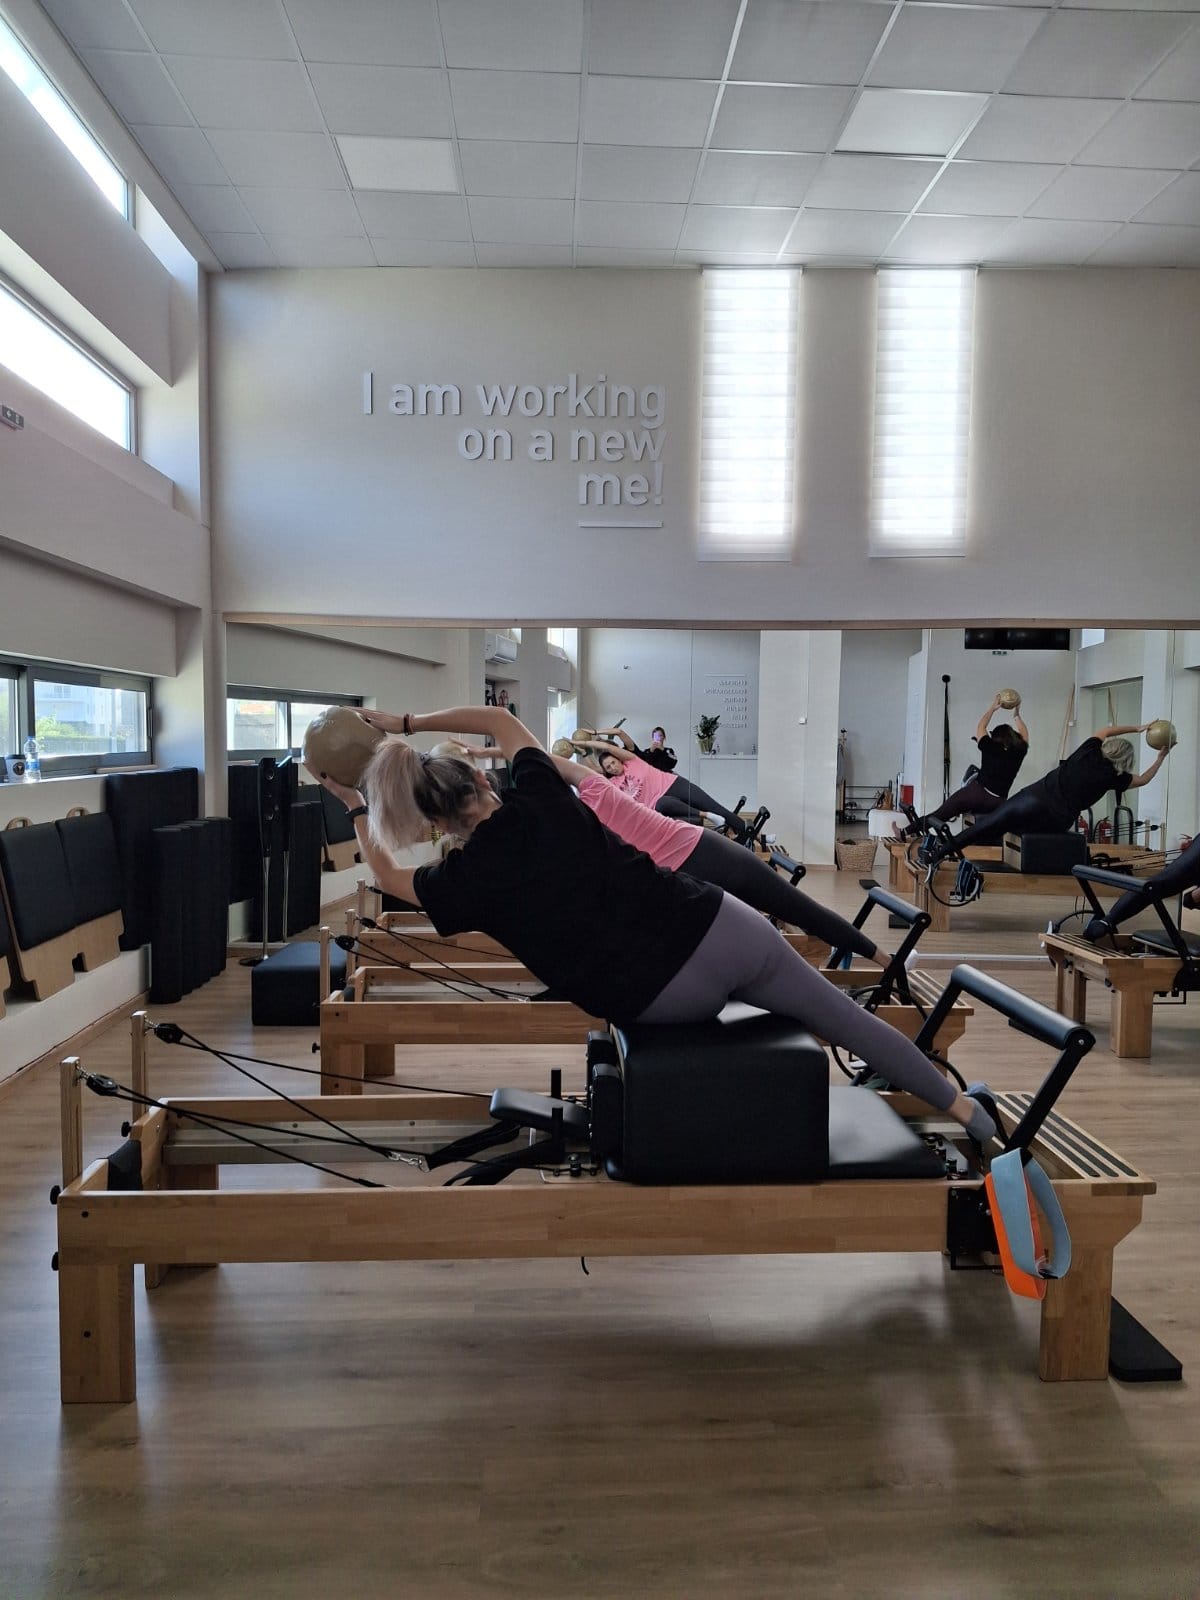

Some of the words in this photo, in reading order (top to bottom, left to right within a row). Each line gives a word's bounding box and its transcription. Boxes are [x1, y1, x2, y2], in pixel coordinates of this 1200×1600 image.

[362, 371, 372, 415] I
[389, 383, 461, 415] am
[477, 373, 666, 430] working
[459, 428, 512, 460] on
[528, 429, 554, 461] a
[570, 429, 666, 461] new
[579, 462, 664, 505] me!
